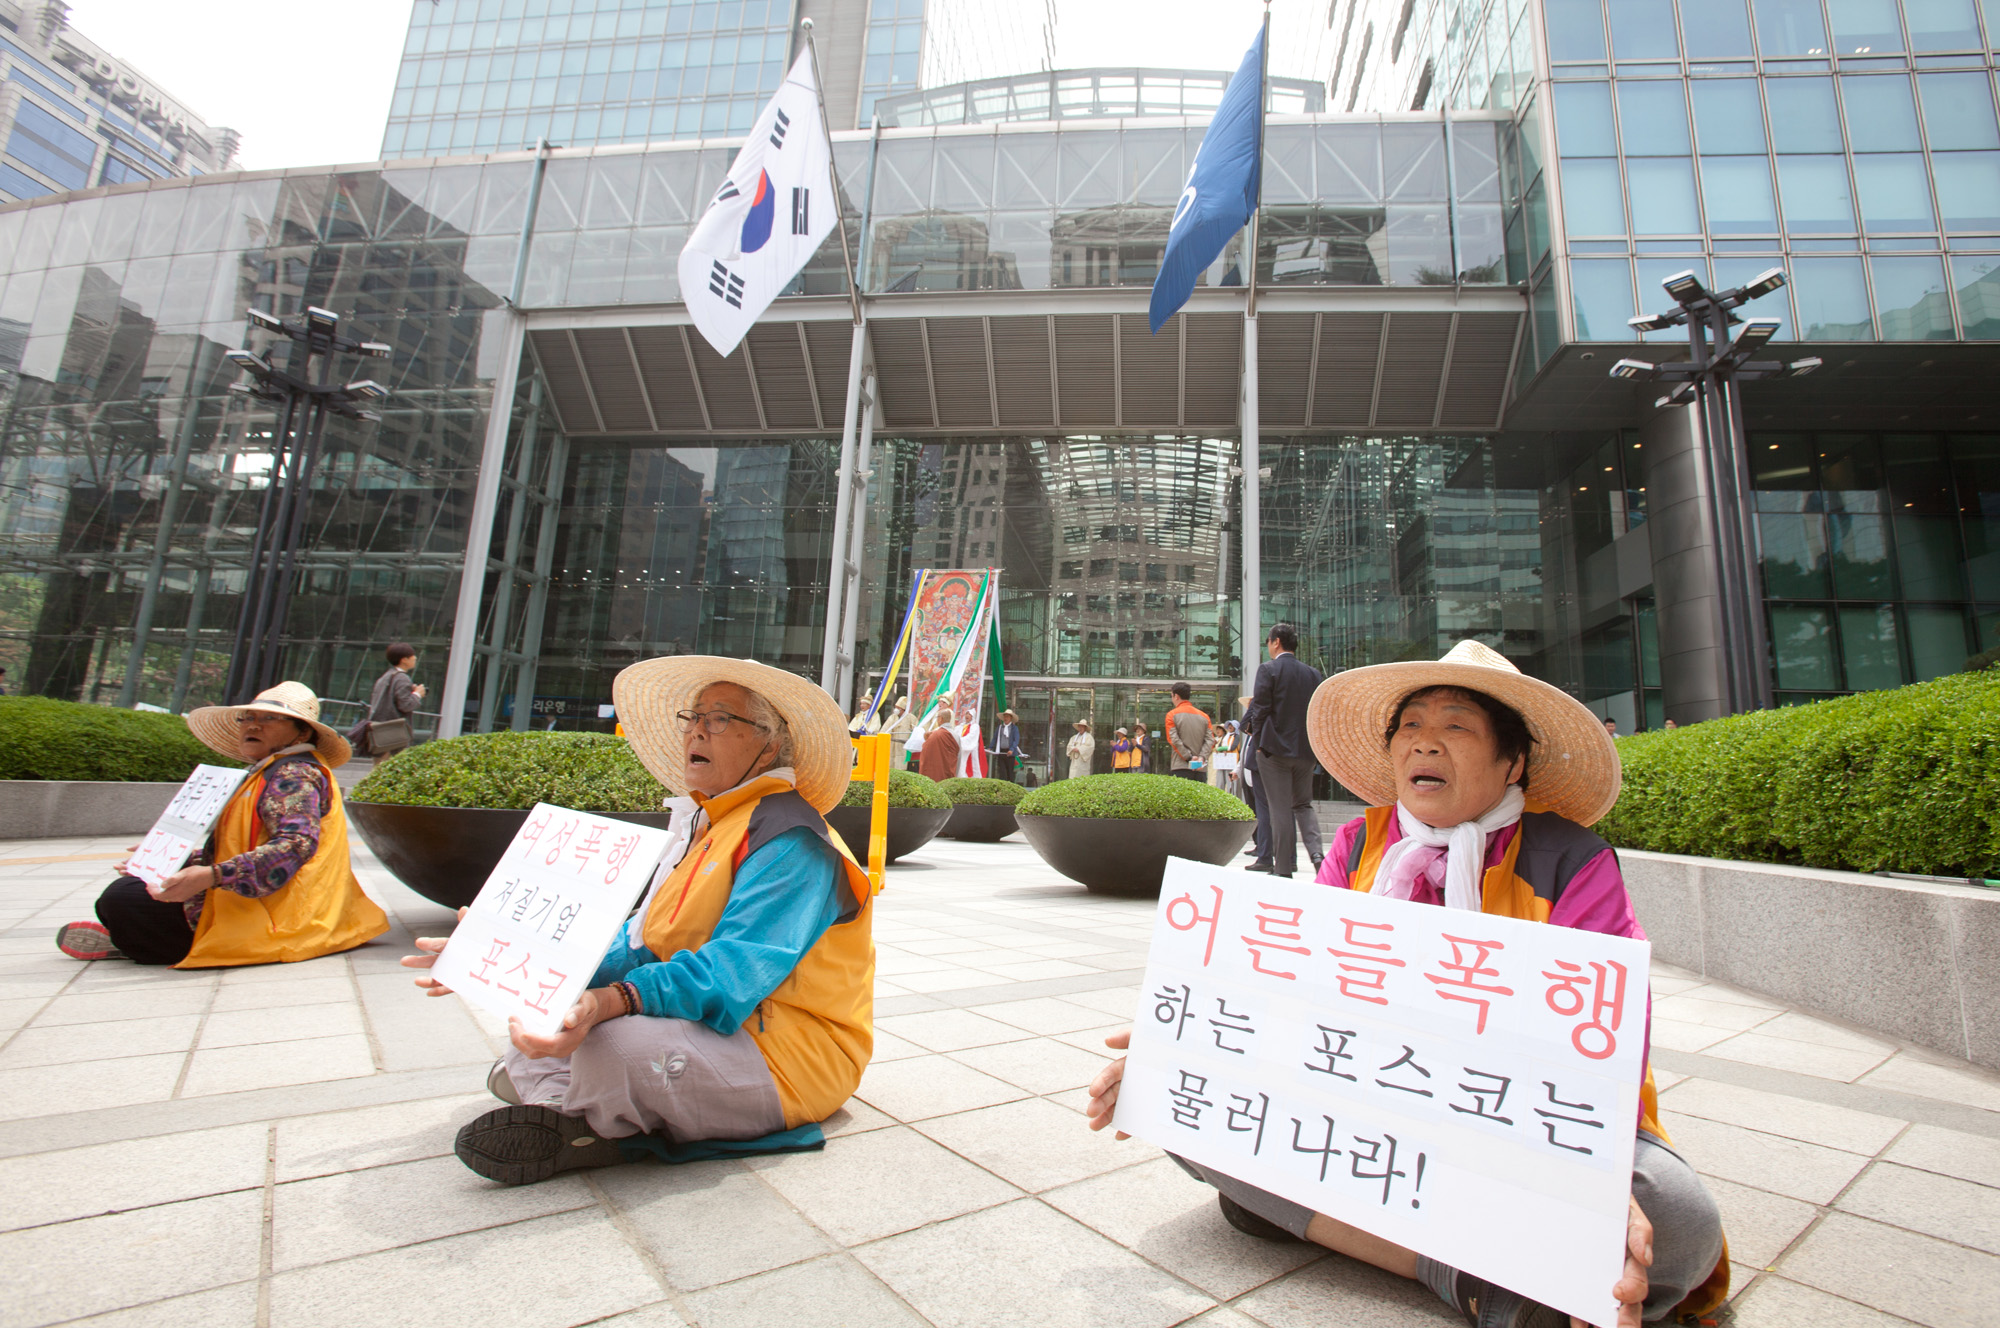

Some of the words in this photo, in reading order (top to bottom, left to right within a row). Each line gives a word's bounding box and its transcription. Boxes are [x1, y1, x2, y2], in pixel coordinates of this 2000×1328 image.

[94, 57, 189, 136] DOHWA
[531, 700, 566, 714] 리은행
[131, 831, 188, 881] 포스코
[522, 813, 641, 885] 여성폭행
[494, 878, 582, 943] 저질기업
[469, 938, 568, 1016] 포스코
[1153, 984, 1255, 1054] 하는
[1304, 1024, 1605, 1156] 포스코는
[1168, 1069, 1427, 1210] 물러나라!
